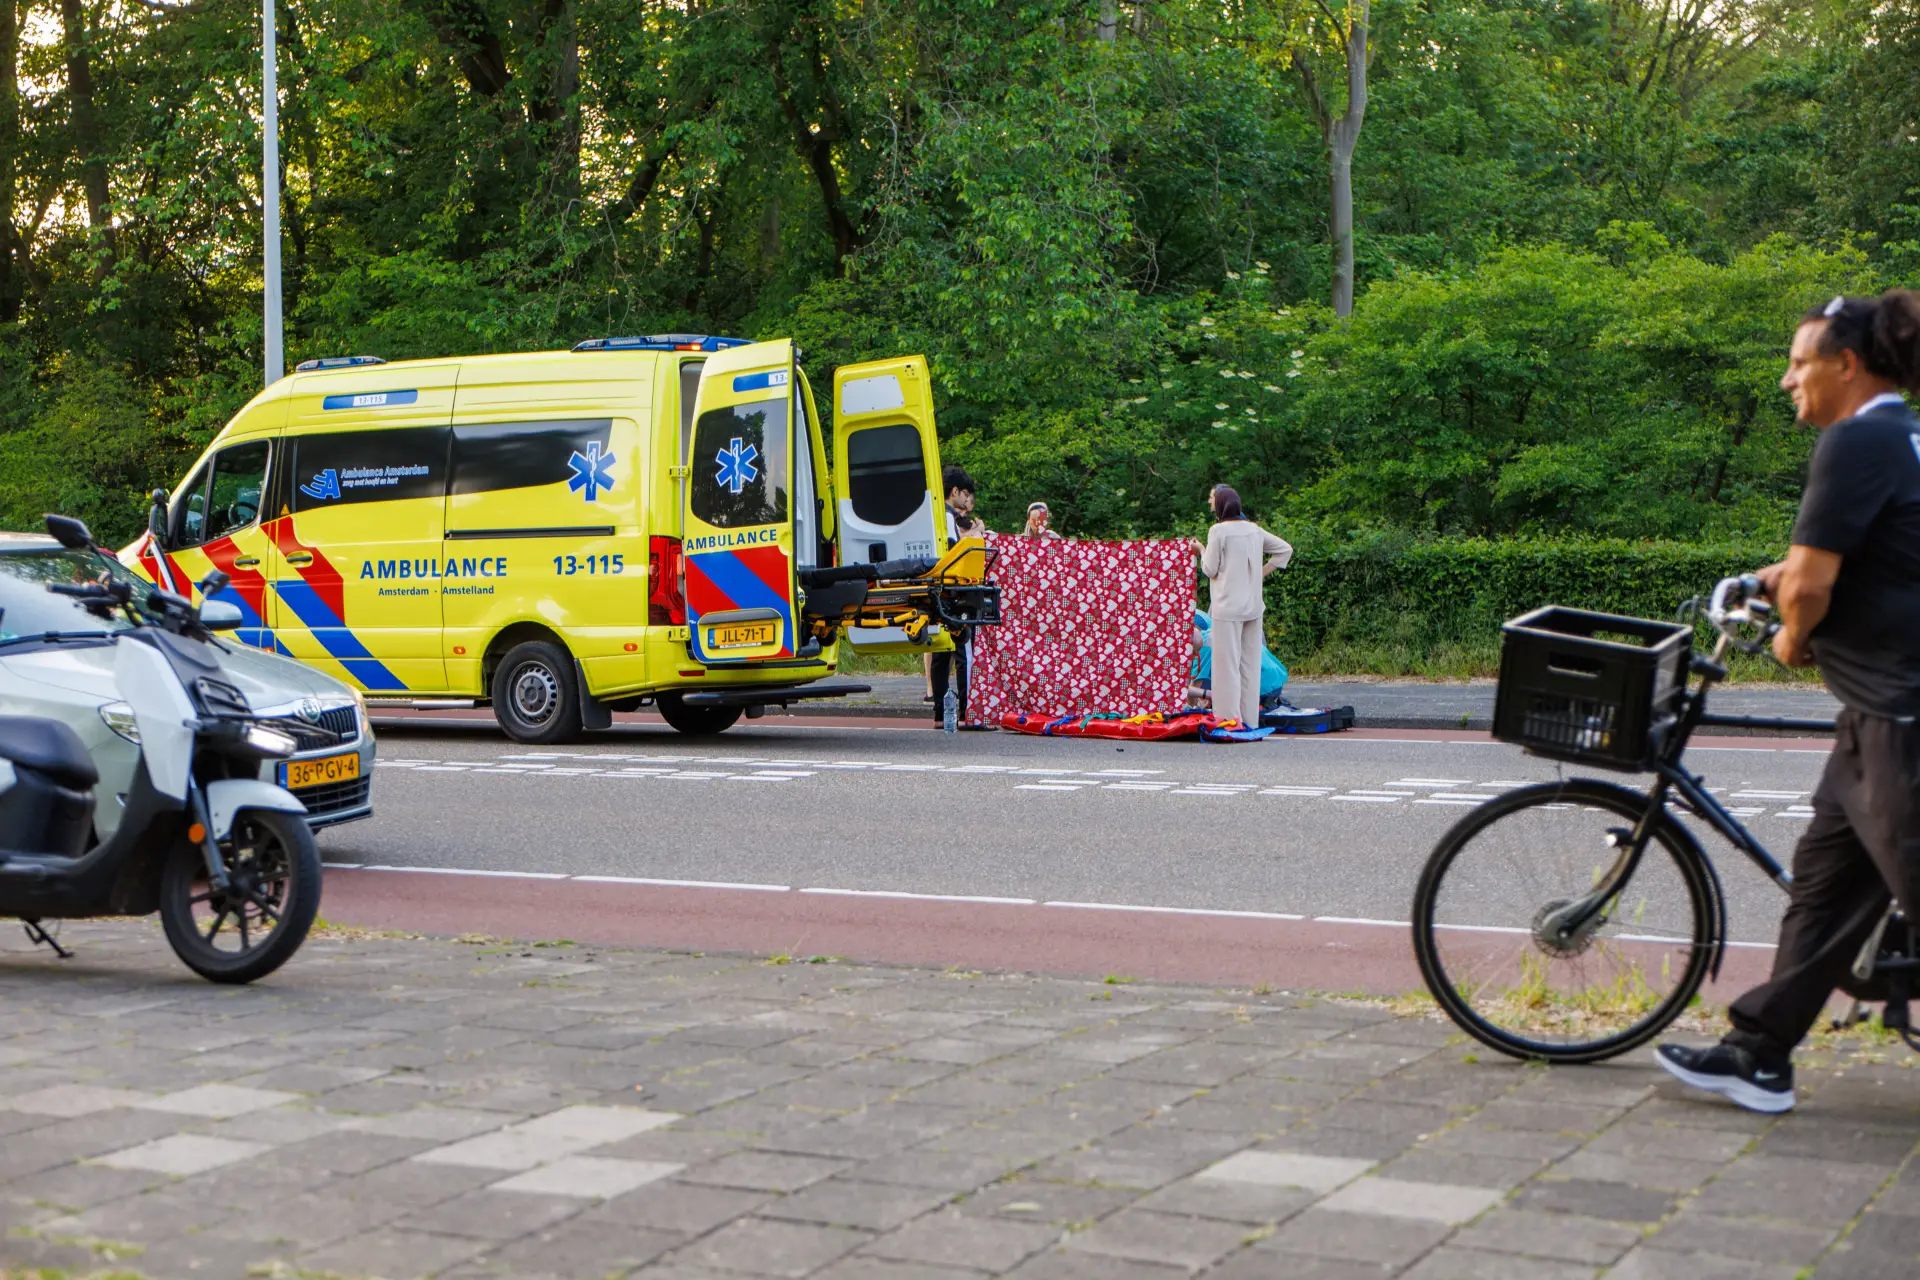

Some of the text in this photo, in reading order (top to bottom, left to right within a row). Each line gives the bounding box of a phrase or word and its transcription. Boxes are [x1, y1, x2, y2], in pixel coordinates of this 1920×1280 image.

[359, 395, 383, 405] 13-115
[341, 464, 430, 479] Ambulance Amsterdam
[686, 528, 777, 551] AMBULANCE
[360, 554, 624, 579] AMBULANCE 13-115
[378, 586, 430, 597] Amsterdam
[442, 585, 495, 596] Amstelland
[721, 627, 766, 643] JLL-71-T
[293, 757, 355, 784] 36-PGV-4
